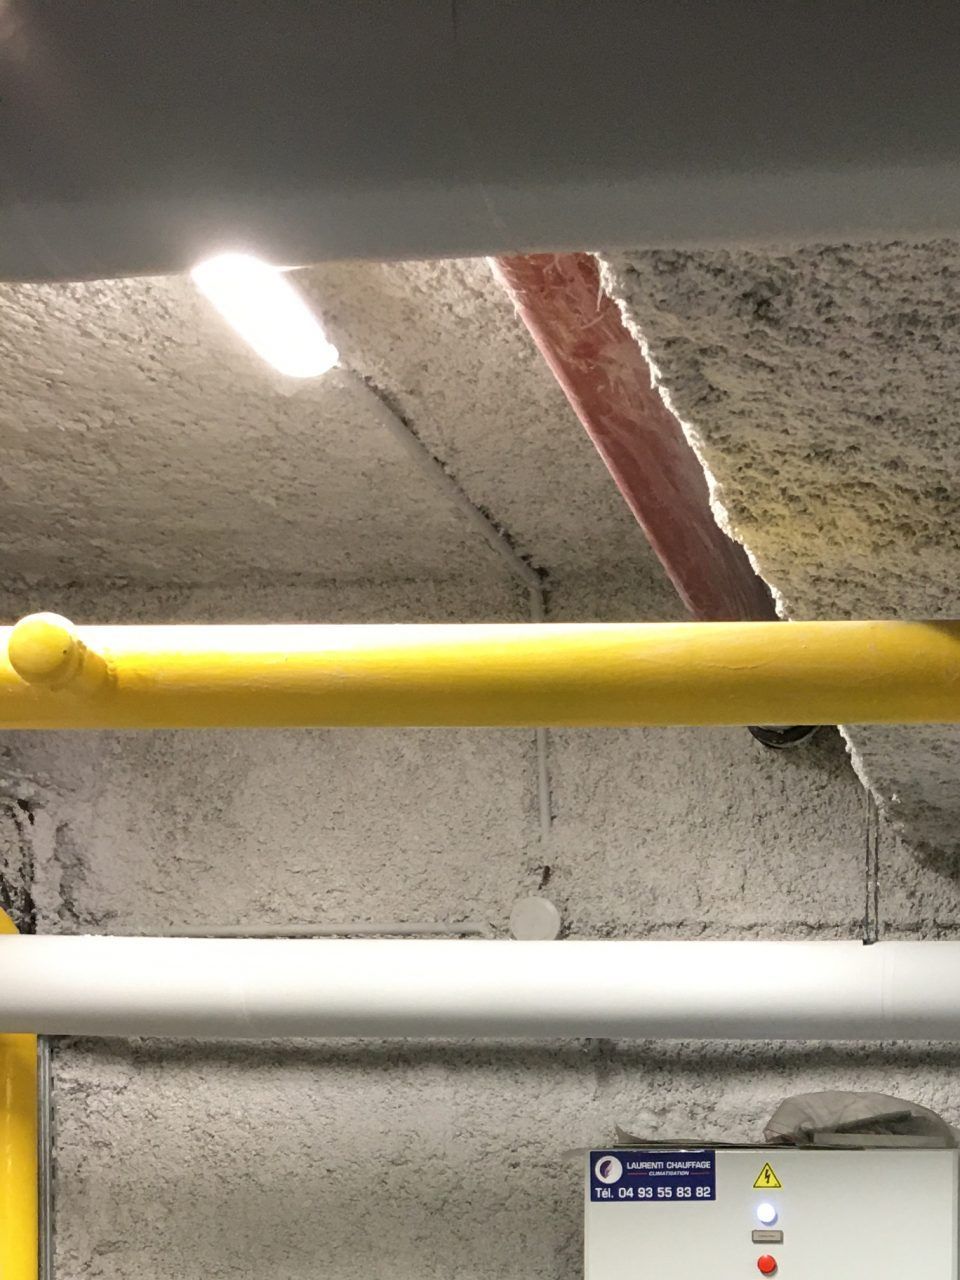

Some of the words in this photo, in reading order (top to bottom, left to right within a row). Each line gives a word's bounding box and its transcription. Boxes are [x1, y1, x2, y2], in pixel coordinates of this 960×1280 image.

[626, 1161, 664, 1170] LAURENTI
[666, 1160, 711, 1170] CHAUFFAGE
[595, 1187, 614, 1199] Tél.
[618, 1187, 634, 1198] 04
[637, 1187, 653, 1198] 93
[657, 1187, 673, 1198] 55
[676, 1186, 692, 1198] 83
[695, 1186, 711, 1198] 82
